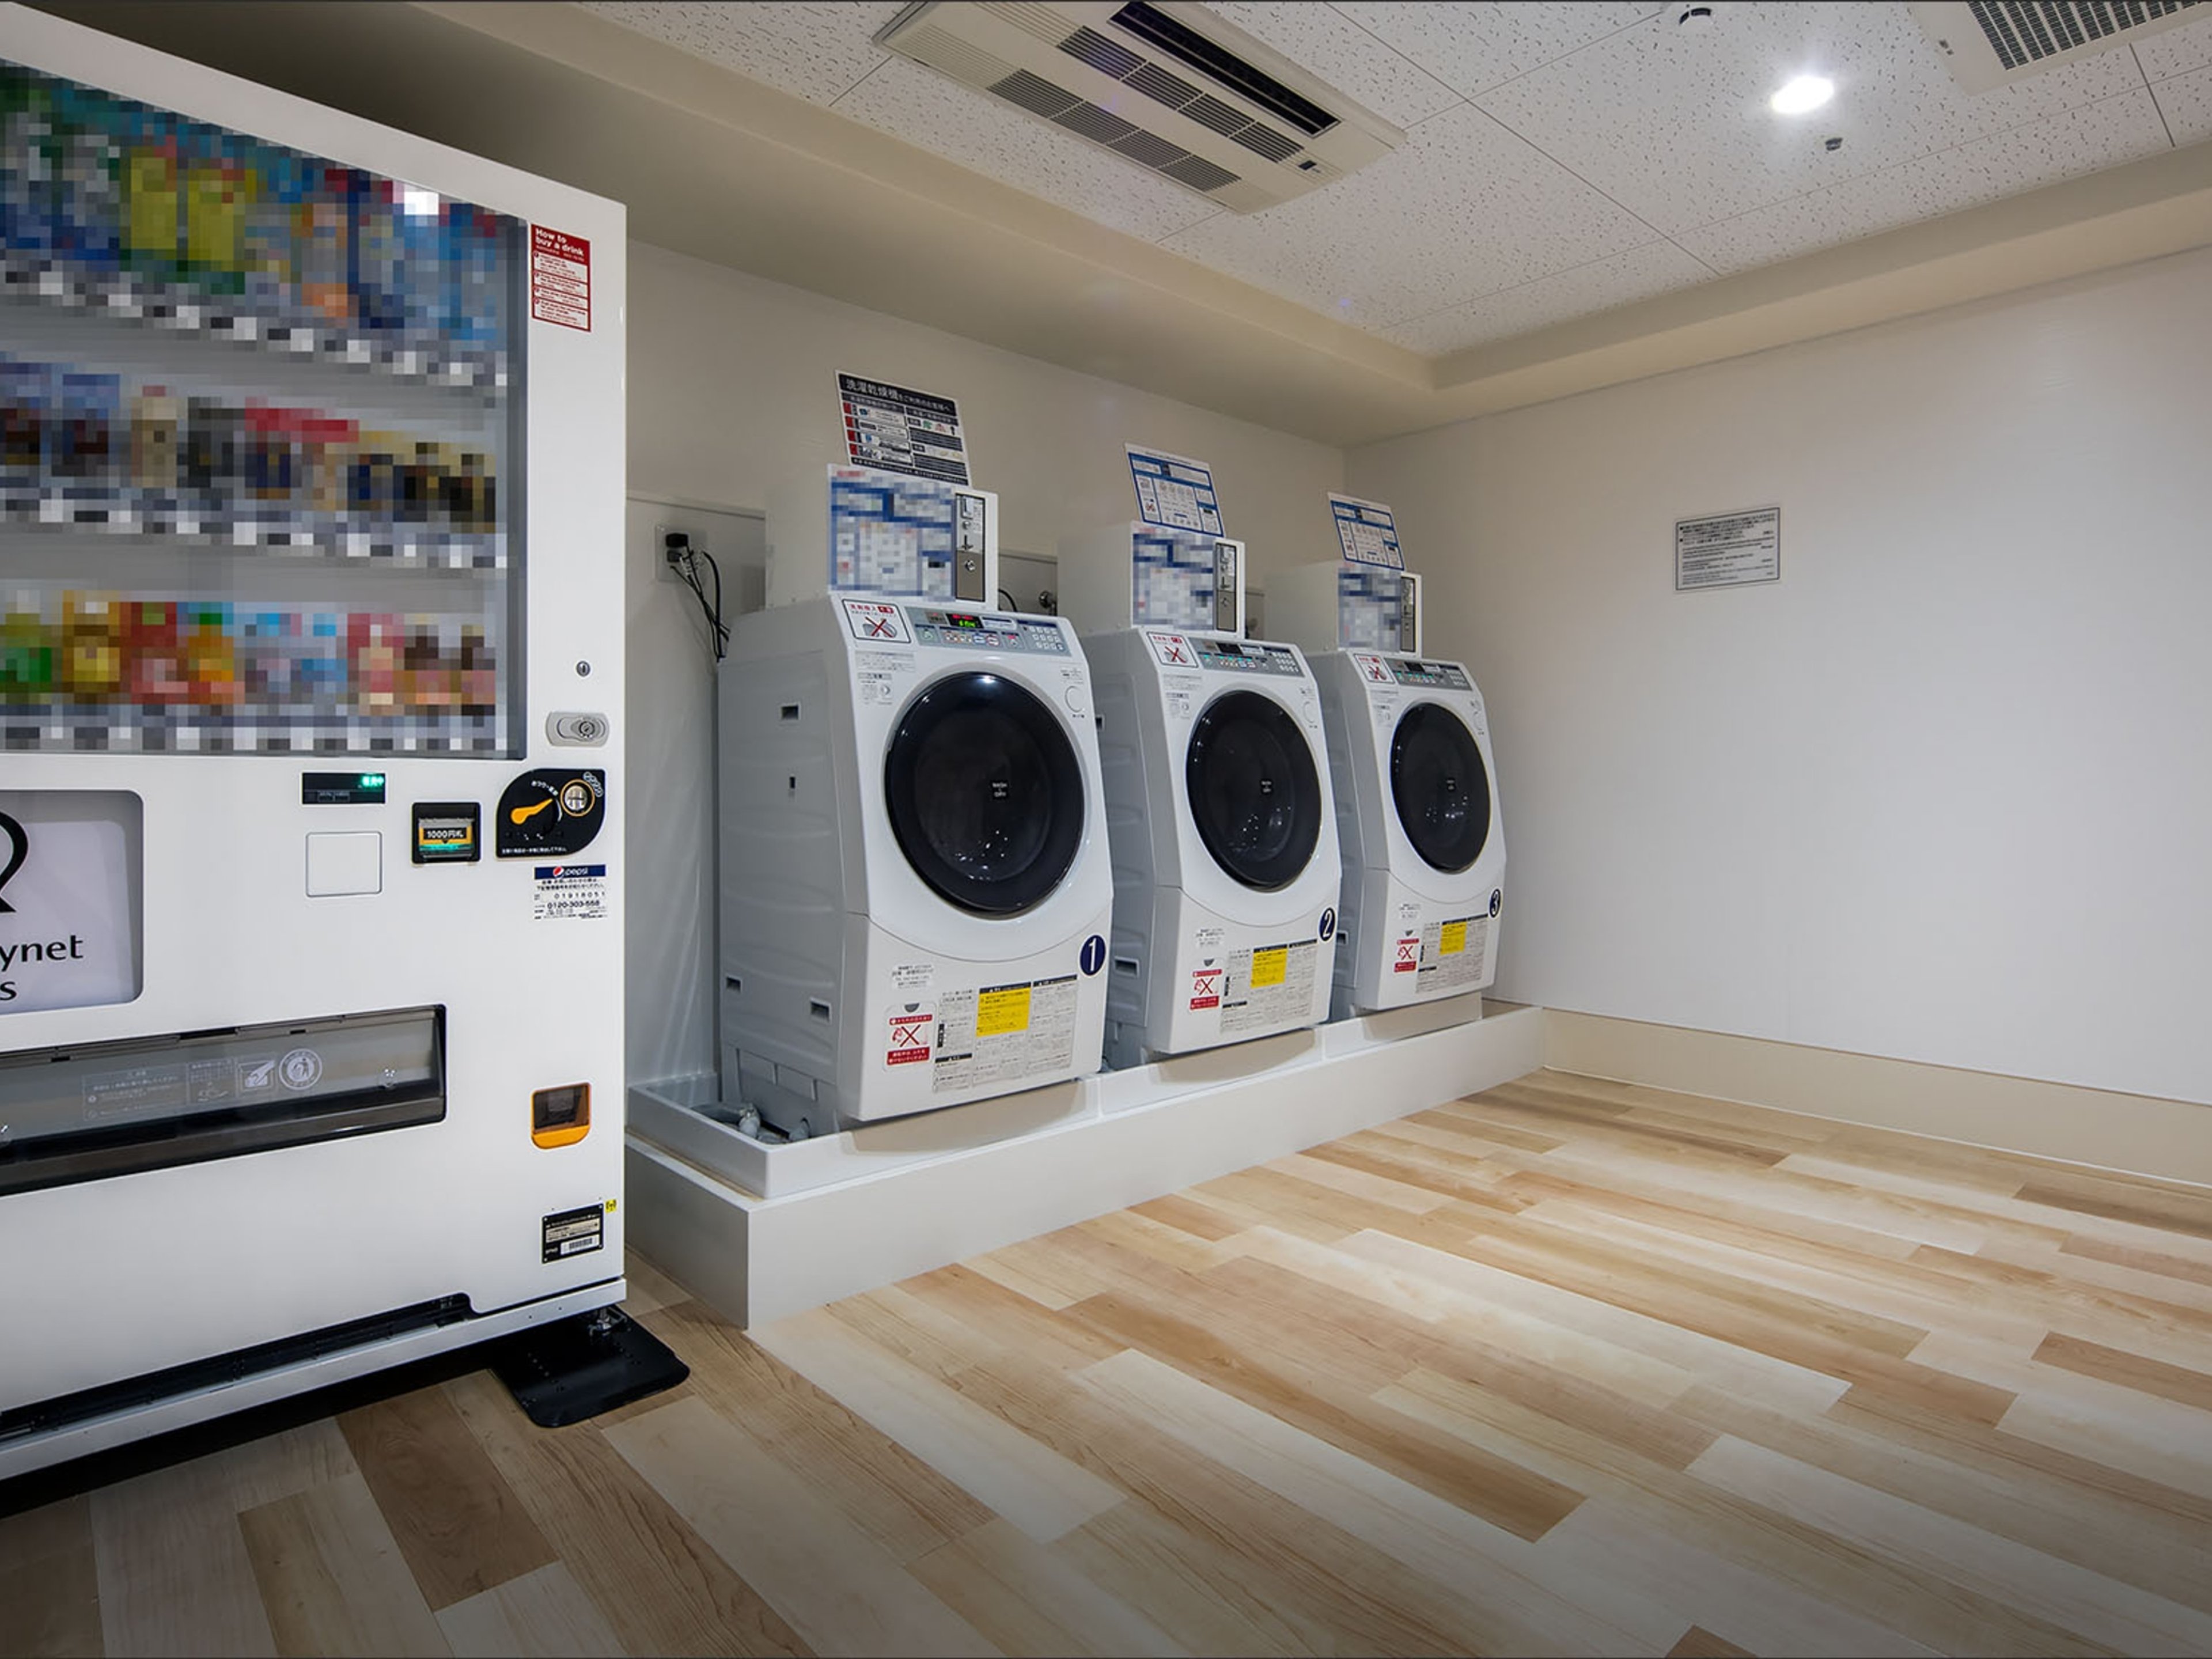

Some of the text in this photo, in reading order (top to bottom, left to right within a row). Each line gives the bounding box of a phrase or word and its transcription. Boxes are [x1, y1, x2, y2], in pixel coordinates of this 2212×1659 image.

[535, 228, 567, 243] How to
[536, 237, 552, 247] buy
[562, 244, 584, 256] drink
[562, 867, 588, 878] pepsi
[1491, 891, 1499, 915] 3
[1323, 910, 1333, 938] 2
[0, 934, 84, 972] ynet
[1089, 938, 1097, 972] 1
